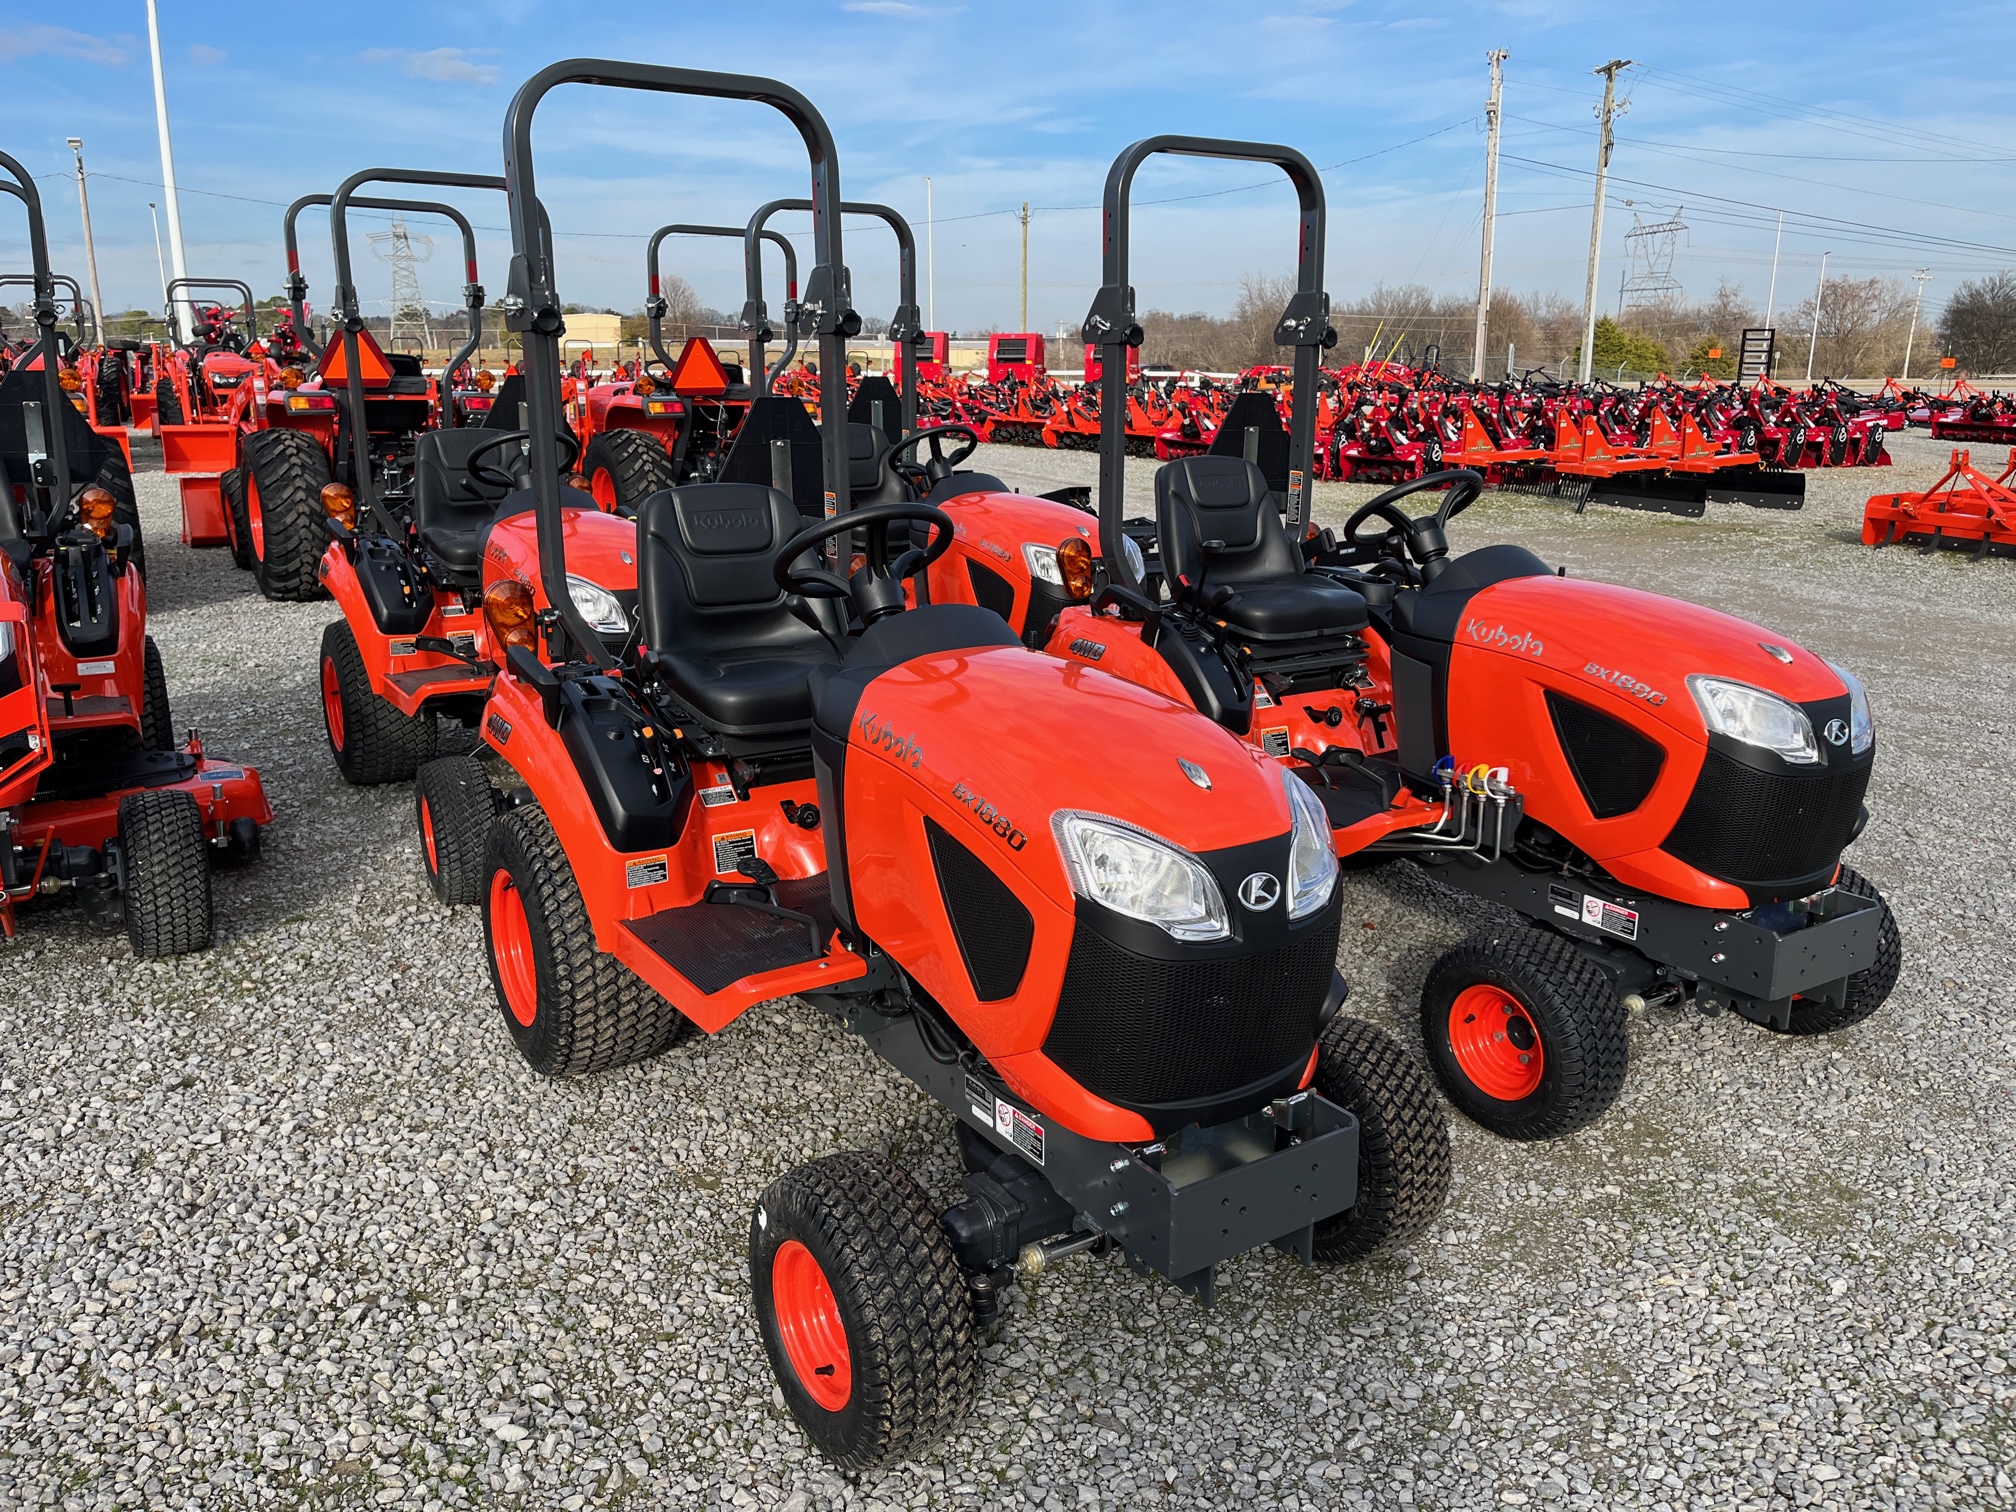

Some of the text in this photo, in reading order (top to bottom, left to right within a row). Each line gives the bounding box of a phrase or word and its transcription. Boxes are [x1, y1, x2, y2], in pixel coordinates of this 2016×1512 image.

[694, 512, 759, 529] Kubota
[1069, 638, 1107, 661] 4WD
[1466, 618, 1543, 657] Kubota
[1583, 662, 1668, 707] BX1880
[487, 712, 512, 745] 4WD
[858, 709, 923, 769] Kubota
[952, 783, 1028, 852] BX1880
